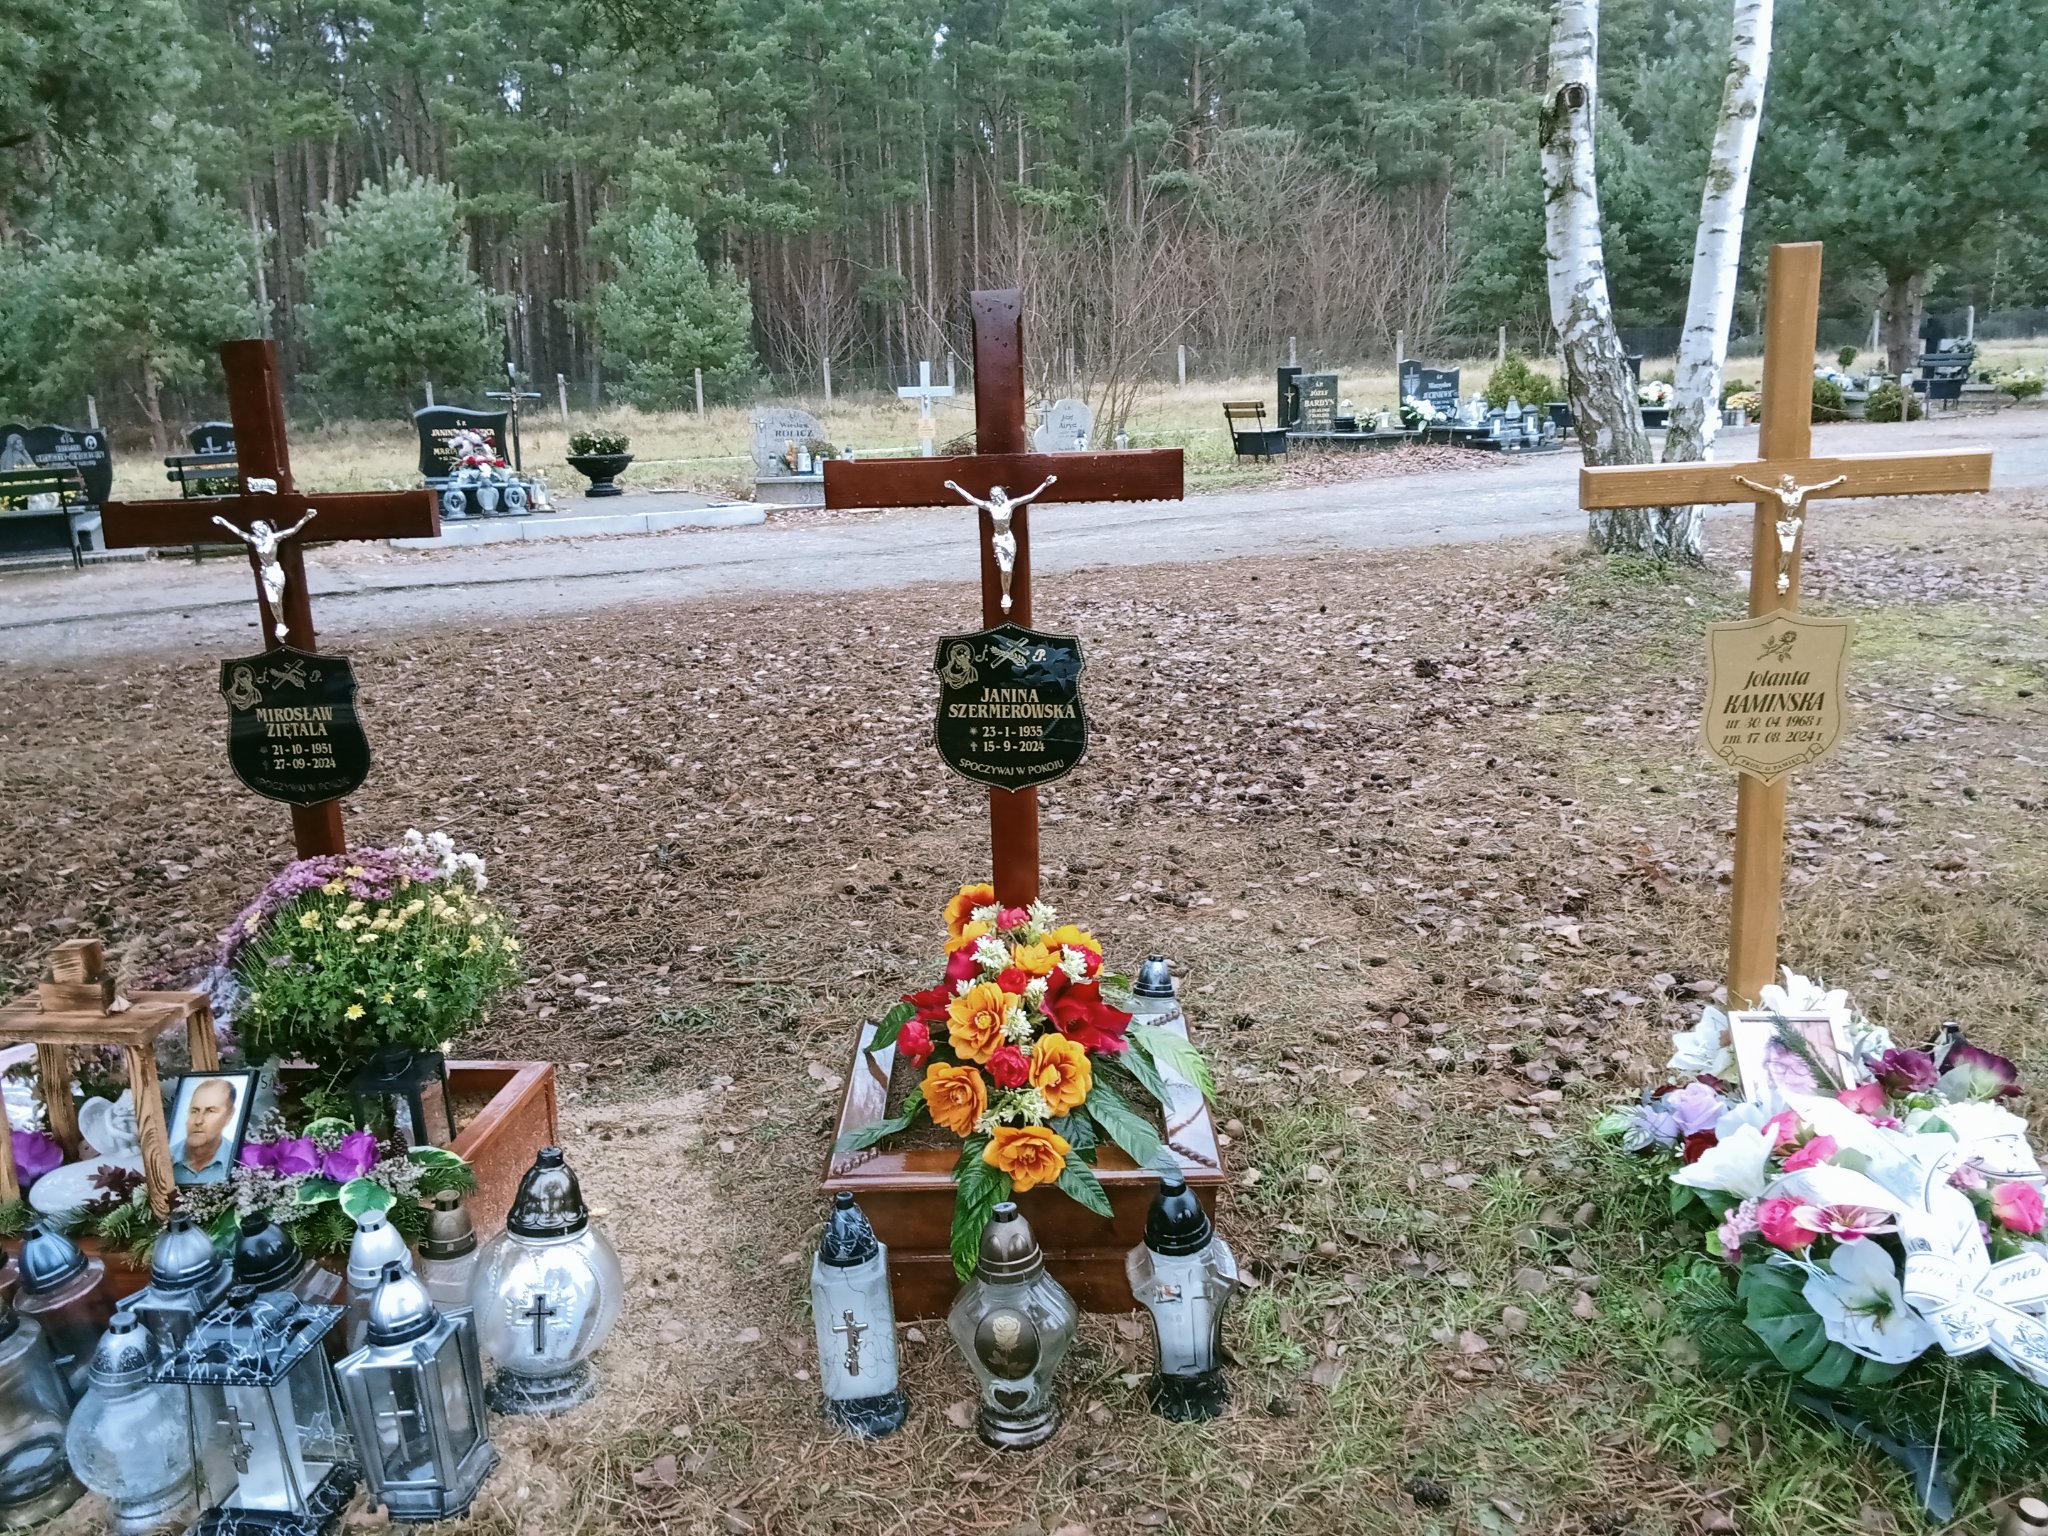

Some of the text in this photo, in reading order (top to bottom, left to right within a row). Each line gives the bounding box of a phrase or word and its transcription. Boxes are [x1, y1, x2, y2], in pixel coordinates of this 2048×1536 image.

[1742, 670, 1811, 691] Jolanta
[980, 687, 1040, 703] JANINA
[255, 706, 333, 722] MIROSŁAW
[948, 703, 1076, 719] SZERMEROWSKA
[959, 757, 1065, 776] SPOCZYWAJ W POKOJU
